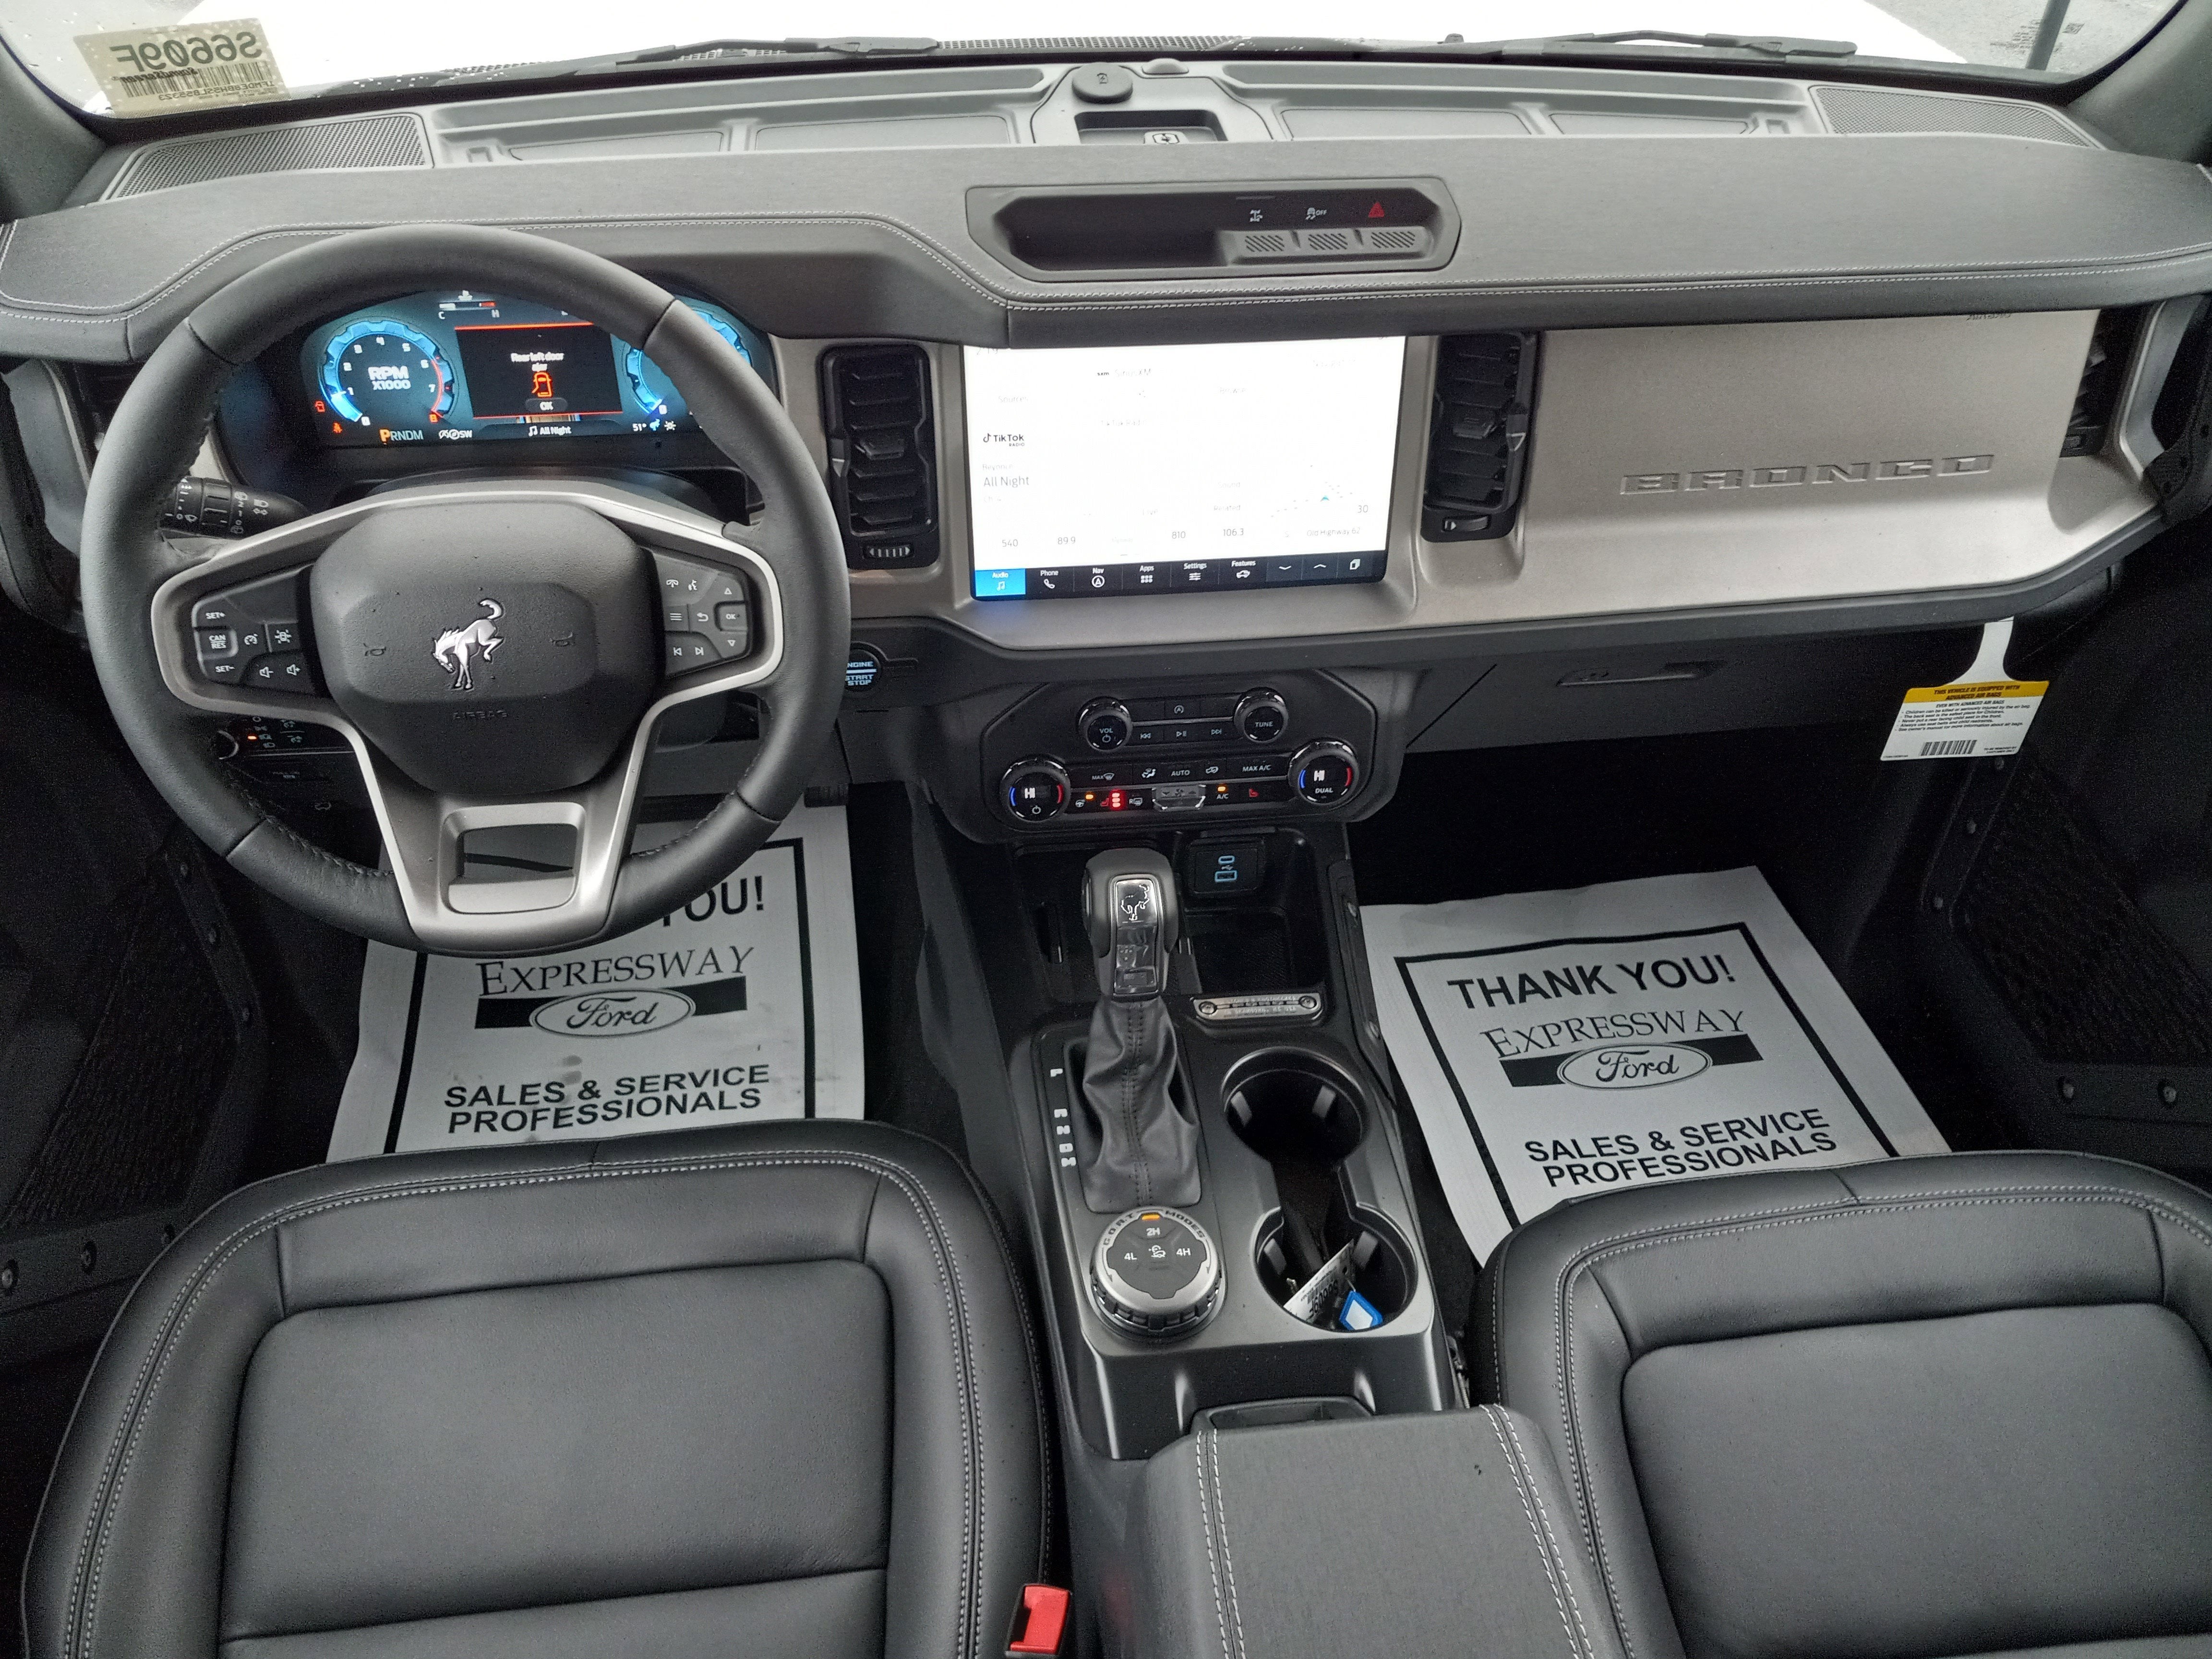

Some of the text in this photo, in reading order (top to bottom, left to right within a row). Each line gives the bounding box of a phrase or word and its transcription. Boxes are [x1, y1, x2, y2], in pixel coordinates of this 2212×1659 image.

[376, 337, 385, 346] 4
[402, 343, 411, 352] 5
[511, 352, 565, 362] Rear left door
[343, 362, 352, 371] 2
[421, 360, 429, 369] 6
[368, 366, 409, 380] RPM
[348, 387, 354, 395] 1
[429, 384, 435, 393] 7
[540, 401, 554, 411] OK
[540, 426, 572, 435] All Night
[993, 433, 1024, 442] TikTok
[1620, 454, 1995, 494] BRONCO
[984, 476, 1029, 488] All Night
[1358, 505, 1368, 513] 30
[1172, 530, 1186, 539] 810
[1223, 528, 1244, 537] 106.3
[1321, 529, 1349, 537] Highway
[1002, 539, 1019, 548] 540
[1447, 954, 1737, 1010] THANK YOU!
[566, 995, 659, 1029] Ford
[1594, 1049, 1680, 1082] Ford
[1050, 1068, 1063, 1077] P
[444, 1064, 770, 1108] SALES & SERVICE
[447, 1087, 762, 1134] PROFESSIONALS
[1524, 1108, 1831, 1165] SALES & SERVICE
[1059, 1143, 1073, 1153] D
[1542, 1132, 1837, 1188] PROFESSIONALS
[1165, 1210, 1206, 1238] MODES
[1146, 1227, 1160, 1237] 2H
[1124, 1252, 1137, 1261] 4L
[1176, 1248, 1191, 1256] 4H
